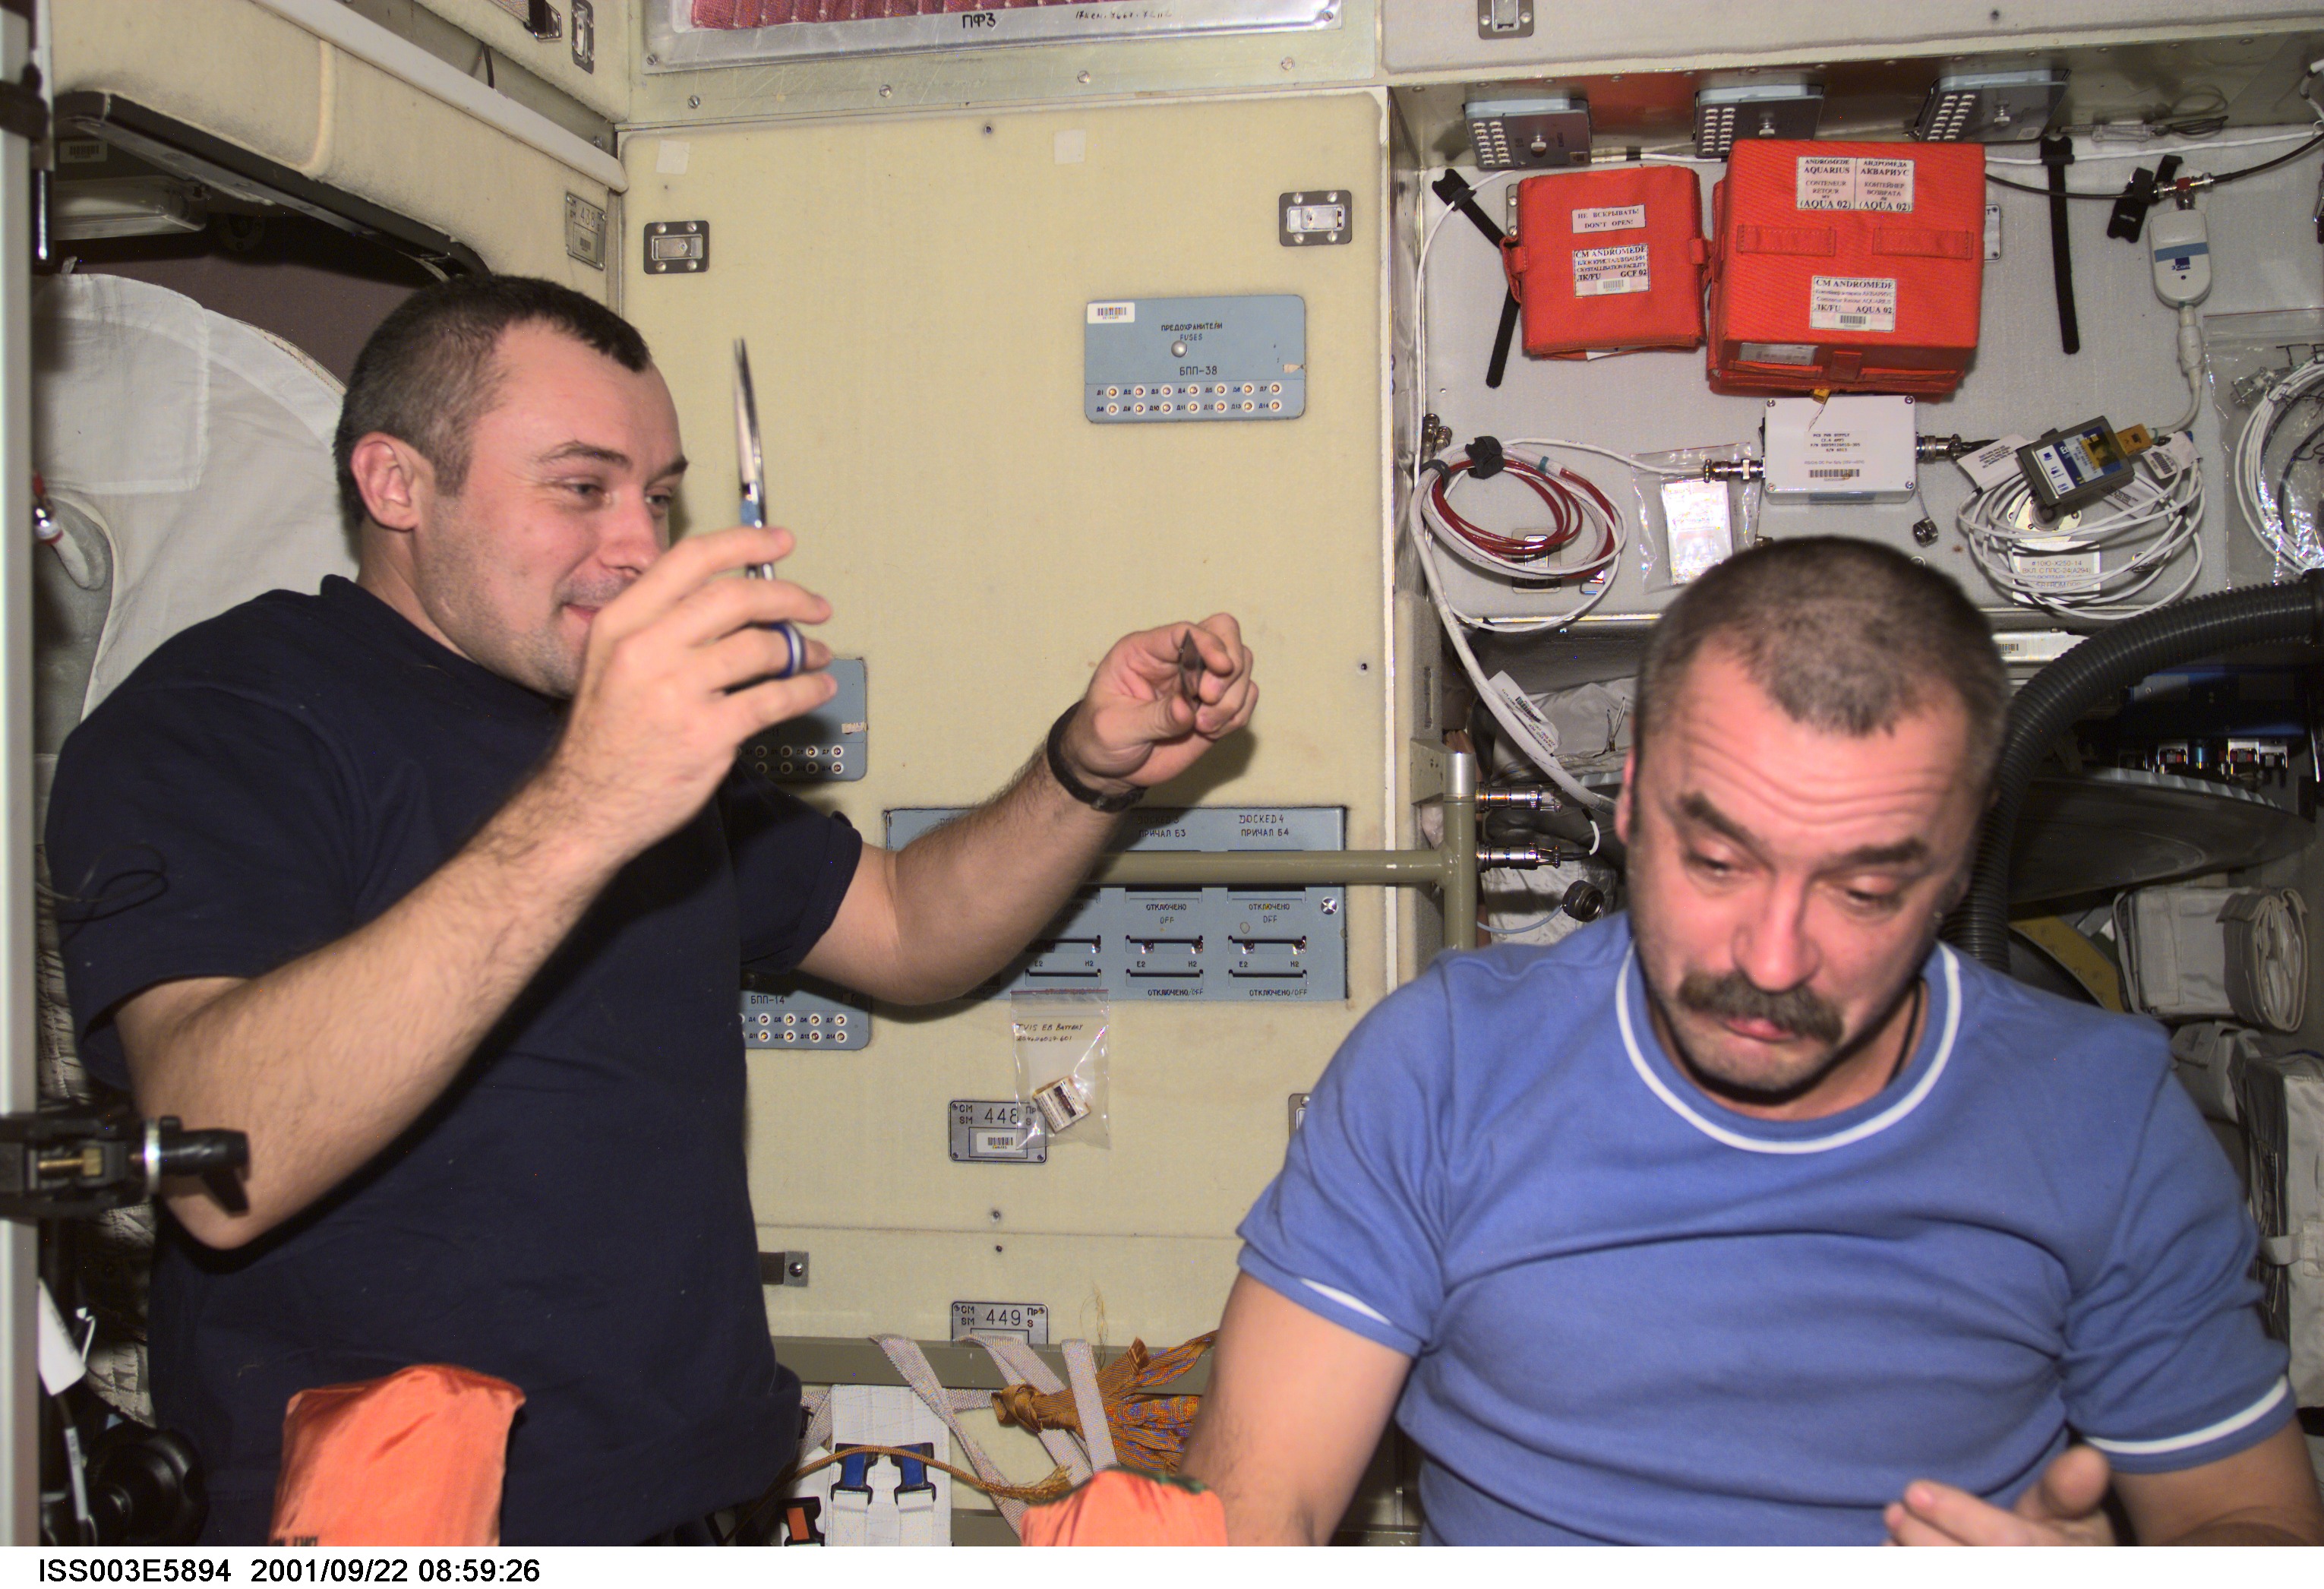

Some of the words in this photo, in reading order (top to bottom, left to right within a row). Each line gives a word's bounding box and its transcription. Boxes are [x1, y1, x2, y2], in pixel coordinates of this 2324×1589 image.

[1861, 168, 1910, 176] АКВАРИУС
[1800, 200, 1833, 210] (AQUA
[1837, 200, 1852, 209] 02)
[1859, 201, 1893, 210] (AQUA
[1896, 202, 1911, 211] 02)
[1593, 209, 1639, 218] ВСКРЫВАТЬ!
[1592, 245, 1647, 257] ANDROMEDE
[1833, 280, 1893, 289] ANDROMEDE
[1161, 322, 1223, 332] ПРЕДОХРАНИТЕЛИ
[1179, 365, 1218, 376] БПП-38
[1239, 815, 1277, 824] DOCKED
[1279, 814, 1284, 823] 4
[1139, 829, 1171, 838] ПРИЧАЛ
[1241, 829, 1274, 837] ПРИЧАЛ
[750, 995, 785, 1004] БПП-14
[985, 1107, 1020, 1124] 448
[1025, 1117, 1032, 1126] S
[1027, 1307, 1038, 1316] Пр
[986, 1309, 1021, 1325] 449
[961, 1317, 974, 1325] SM
[1027, 1319, 1034, 1328] S
